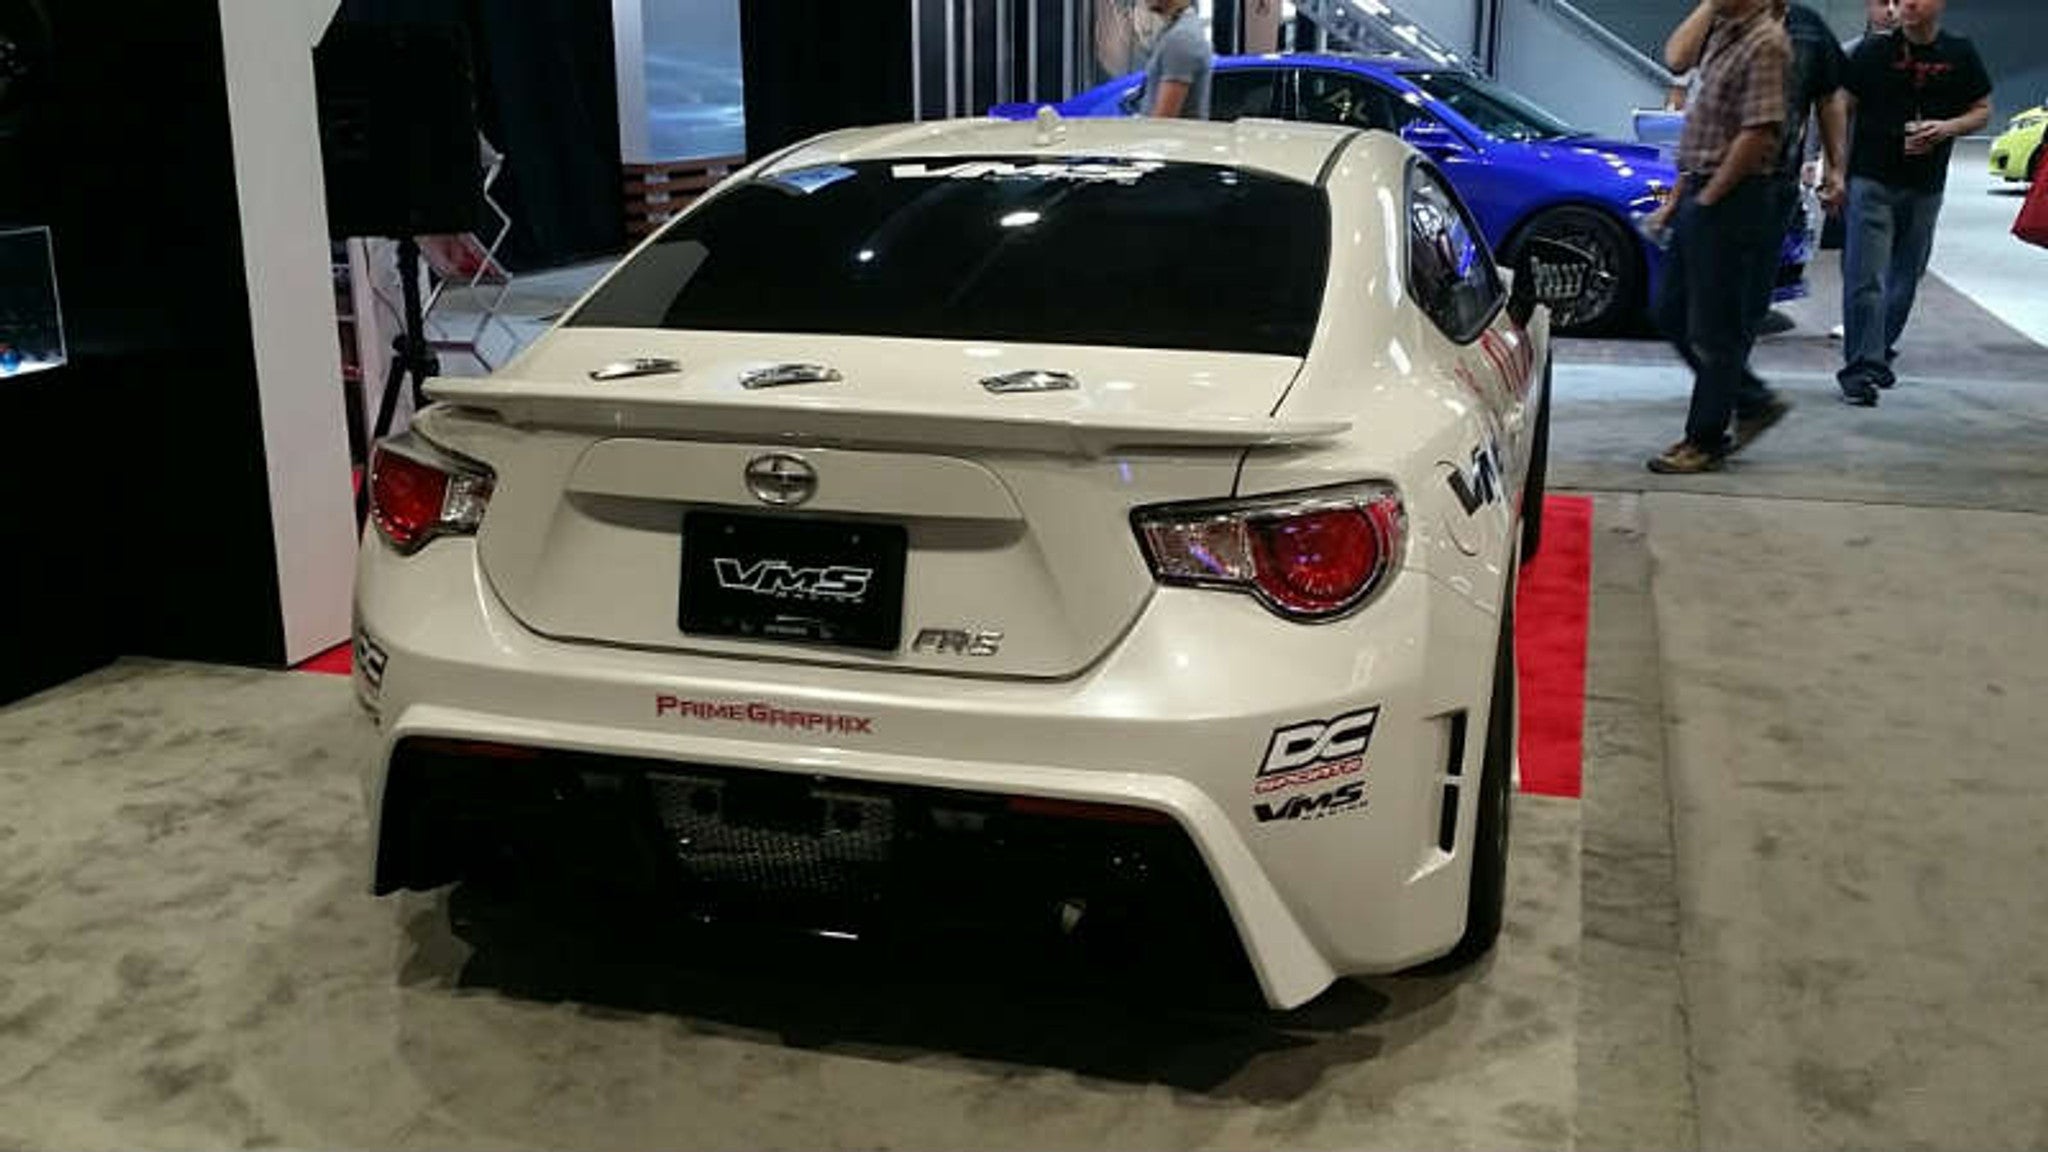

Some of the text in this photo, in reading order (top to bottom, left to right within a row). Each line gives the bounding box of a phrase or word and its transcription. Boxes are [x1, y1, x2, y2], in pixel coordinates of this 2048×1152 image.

[713, 557, 873, 596] VMS
[1256, 704, 1382, 777] DC
[1253, 780, 1366, 822] VMS
